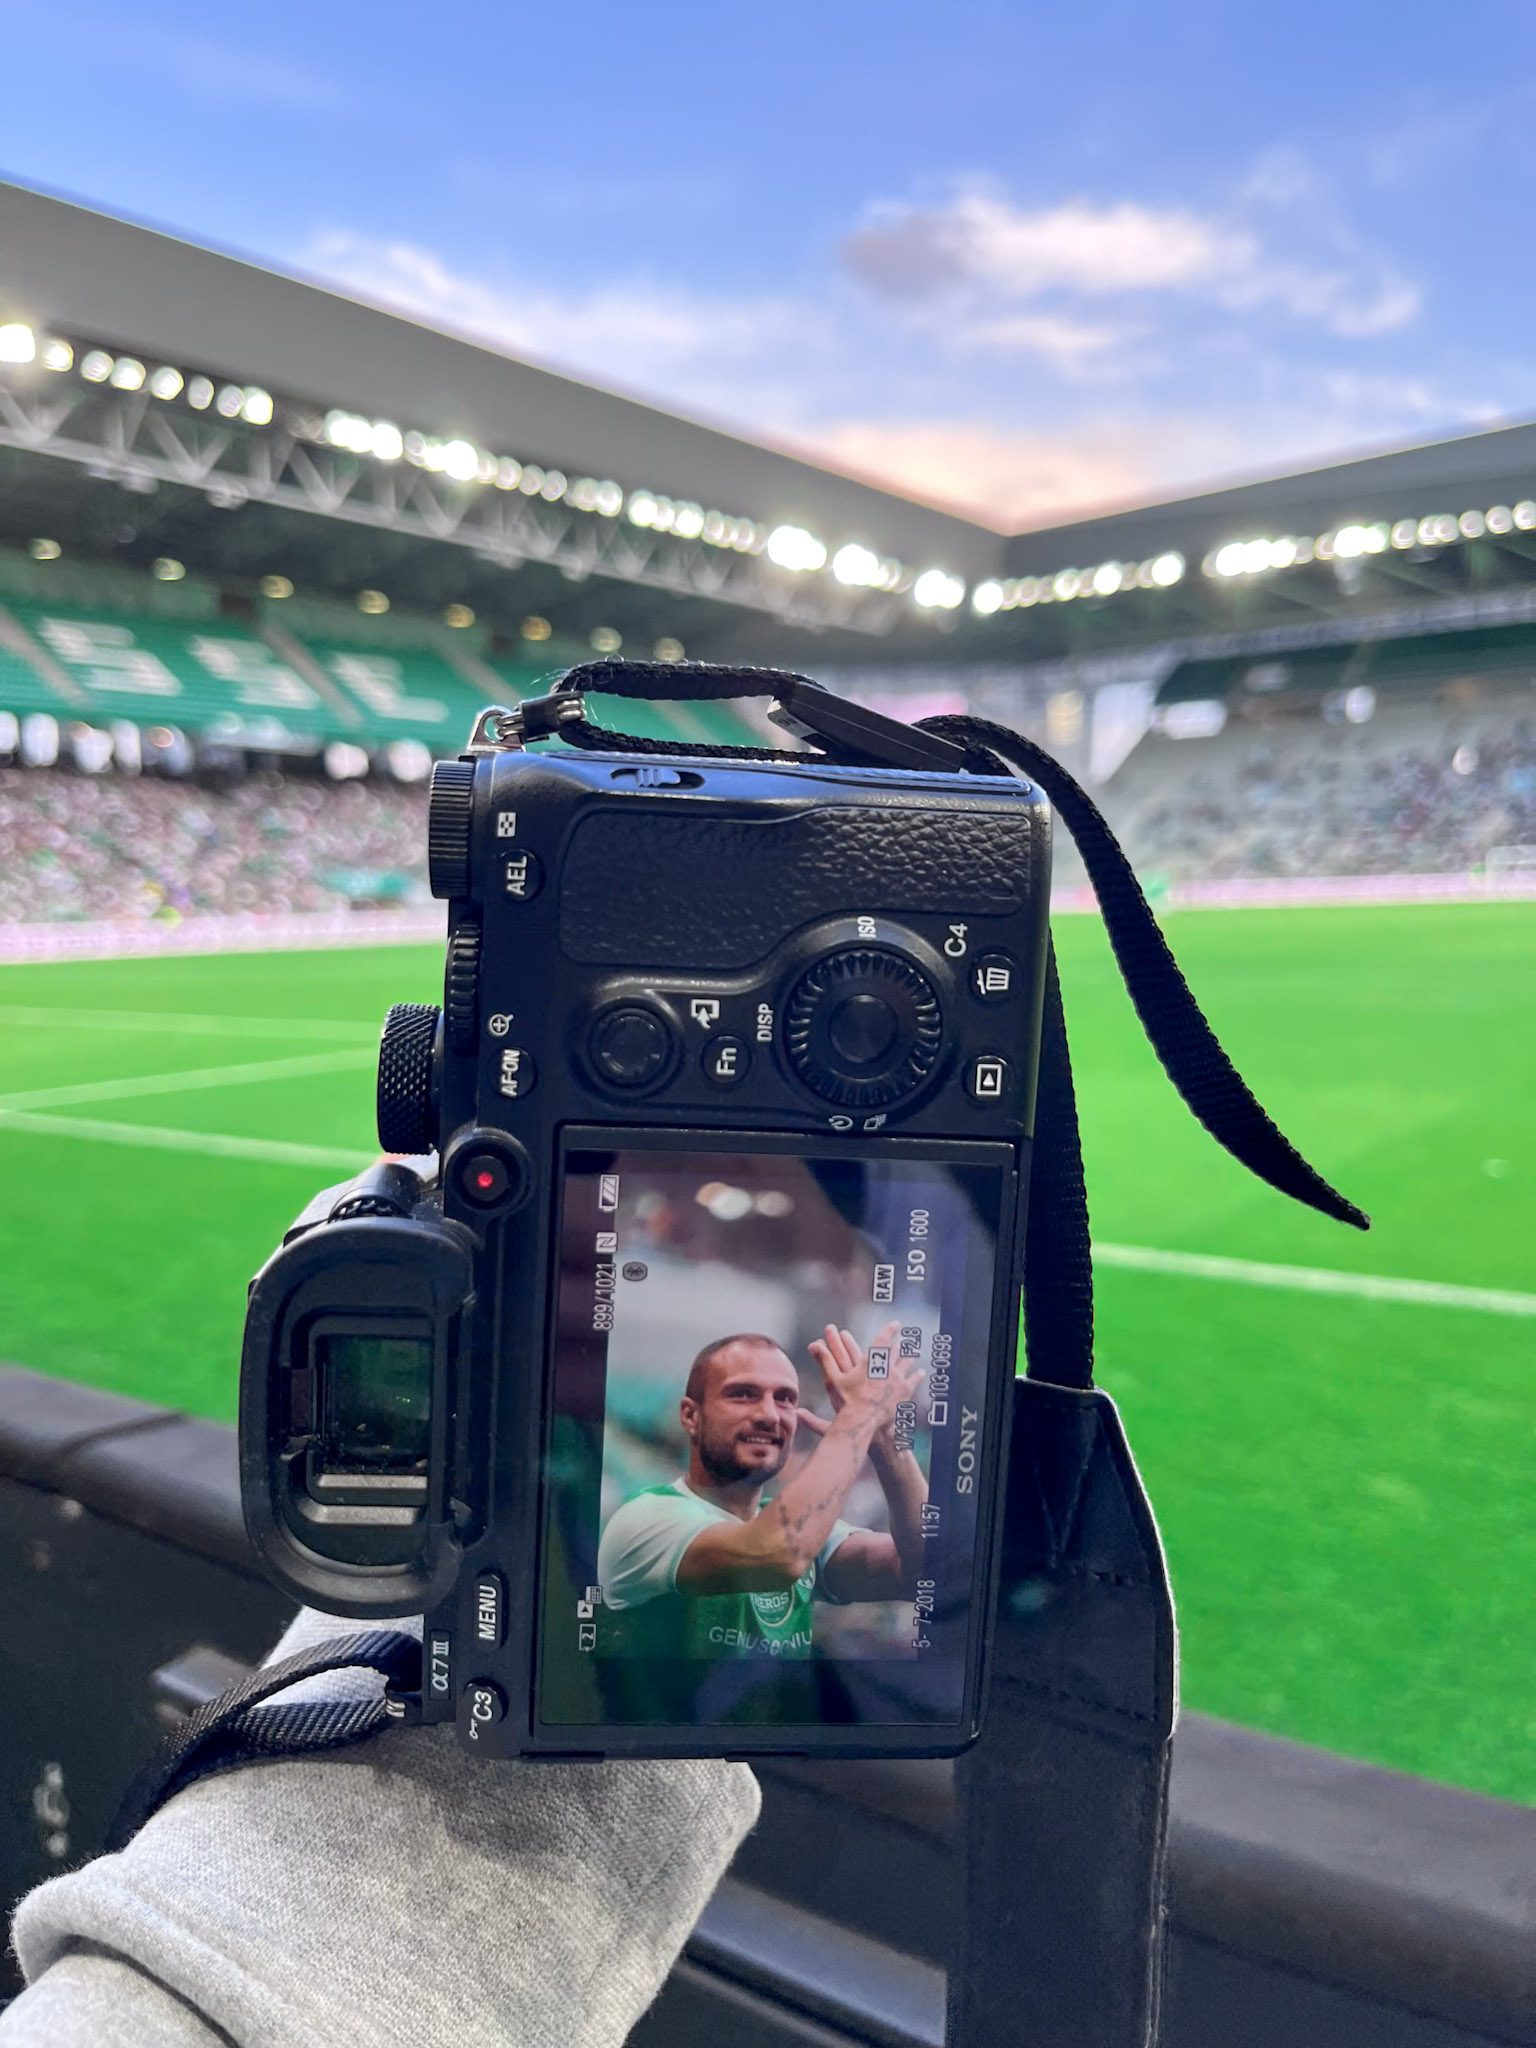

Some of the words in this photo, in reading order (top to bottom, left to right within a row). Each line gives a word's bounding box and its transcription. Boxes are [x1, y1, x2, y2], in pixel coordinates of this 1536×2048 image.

[506, 855, 528, 895] AEL
[857, 915, 877, 938] ISO
[944, 923, 968, 957] C4
[757, 1003, 774, 1042] DISP
[716, 1047, 737, 1075] Fn
[909, 1208, 929, 1242] 1600
[906, 1248, 925, 1280] ISO
[593, 1261, 616, 1330] 899/1021
[875, 1265, 892, 1299] RAW
[900, 1326, 921, 1357] F2.8
[870, 1350, 887, 1374] 3:2
[930, 1332, 952, 1397] 103-0698
[956, 1405, 978, 1493] SONY
[478, 1584, 497, 1640] MENU
[472, 1689, 493, 1720] C3
